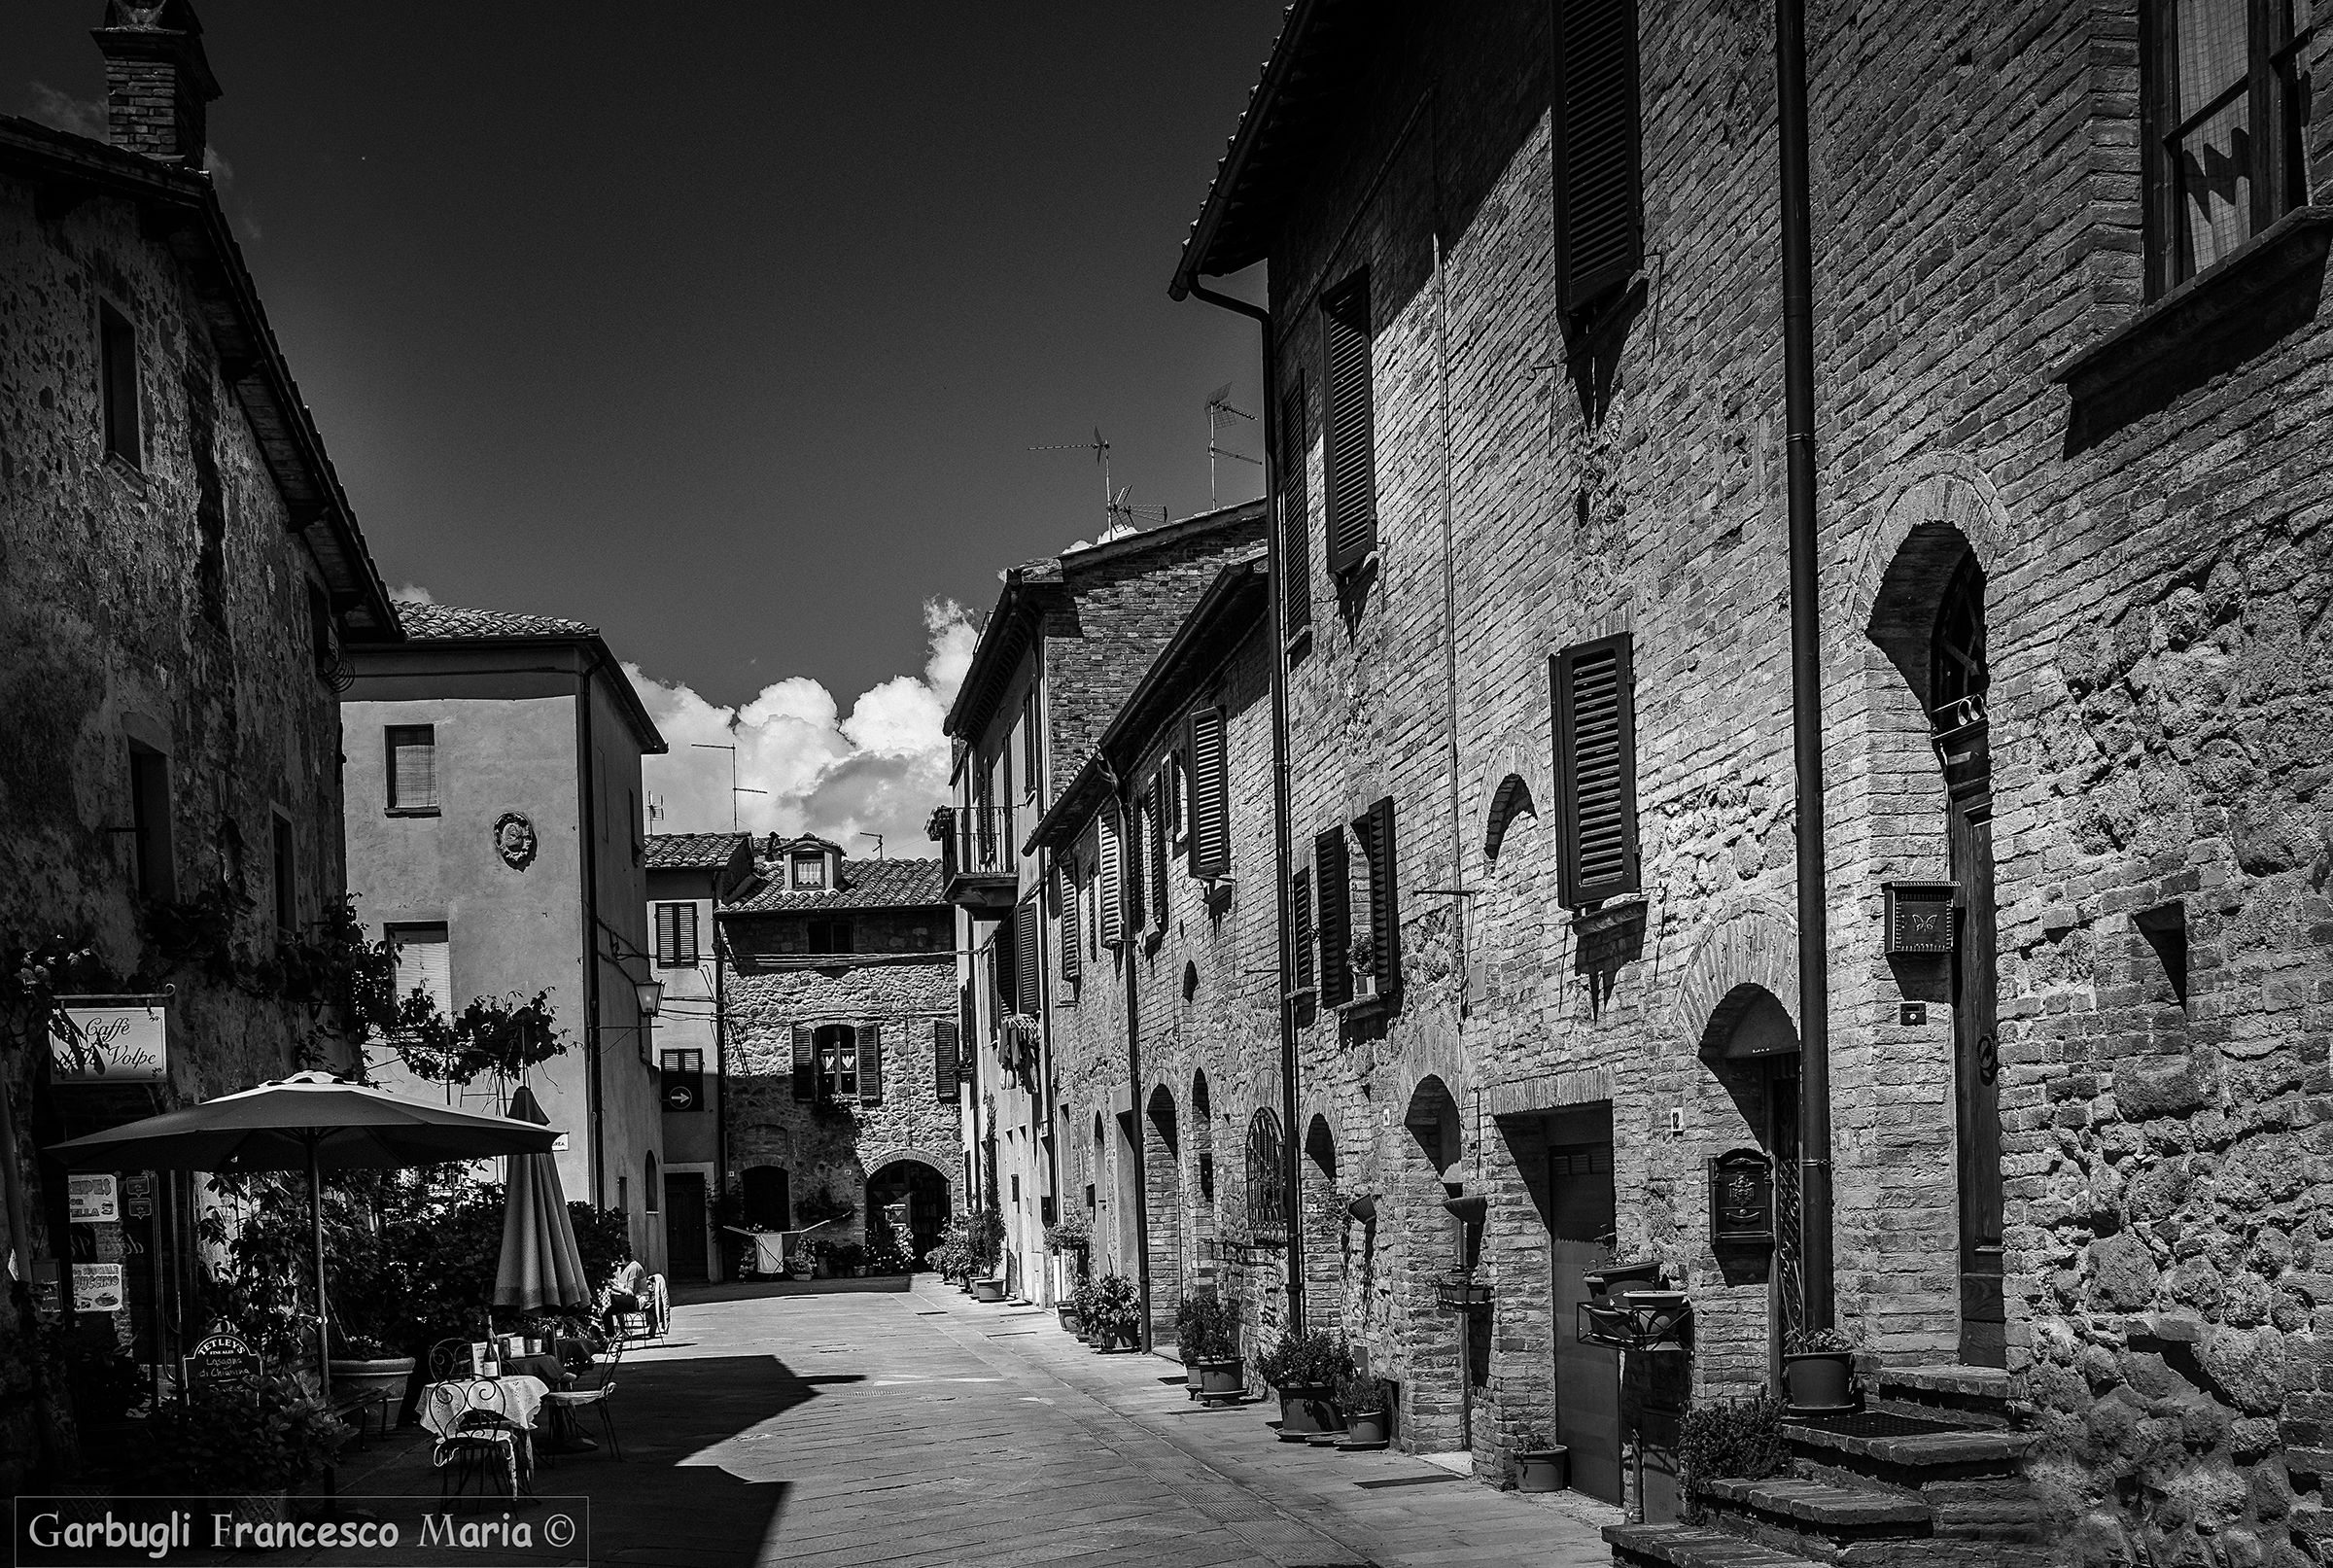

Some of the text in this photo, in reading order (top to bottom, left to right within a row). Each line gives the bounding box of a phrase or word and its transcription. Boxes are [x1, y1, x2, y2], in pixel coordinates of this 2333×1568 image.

[85, 1017, 130, 1042] Caffè
[108, 1045, 157, 1070] Volpe
[197, 1339, 246, 1355] TETLEY'S
